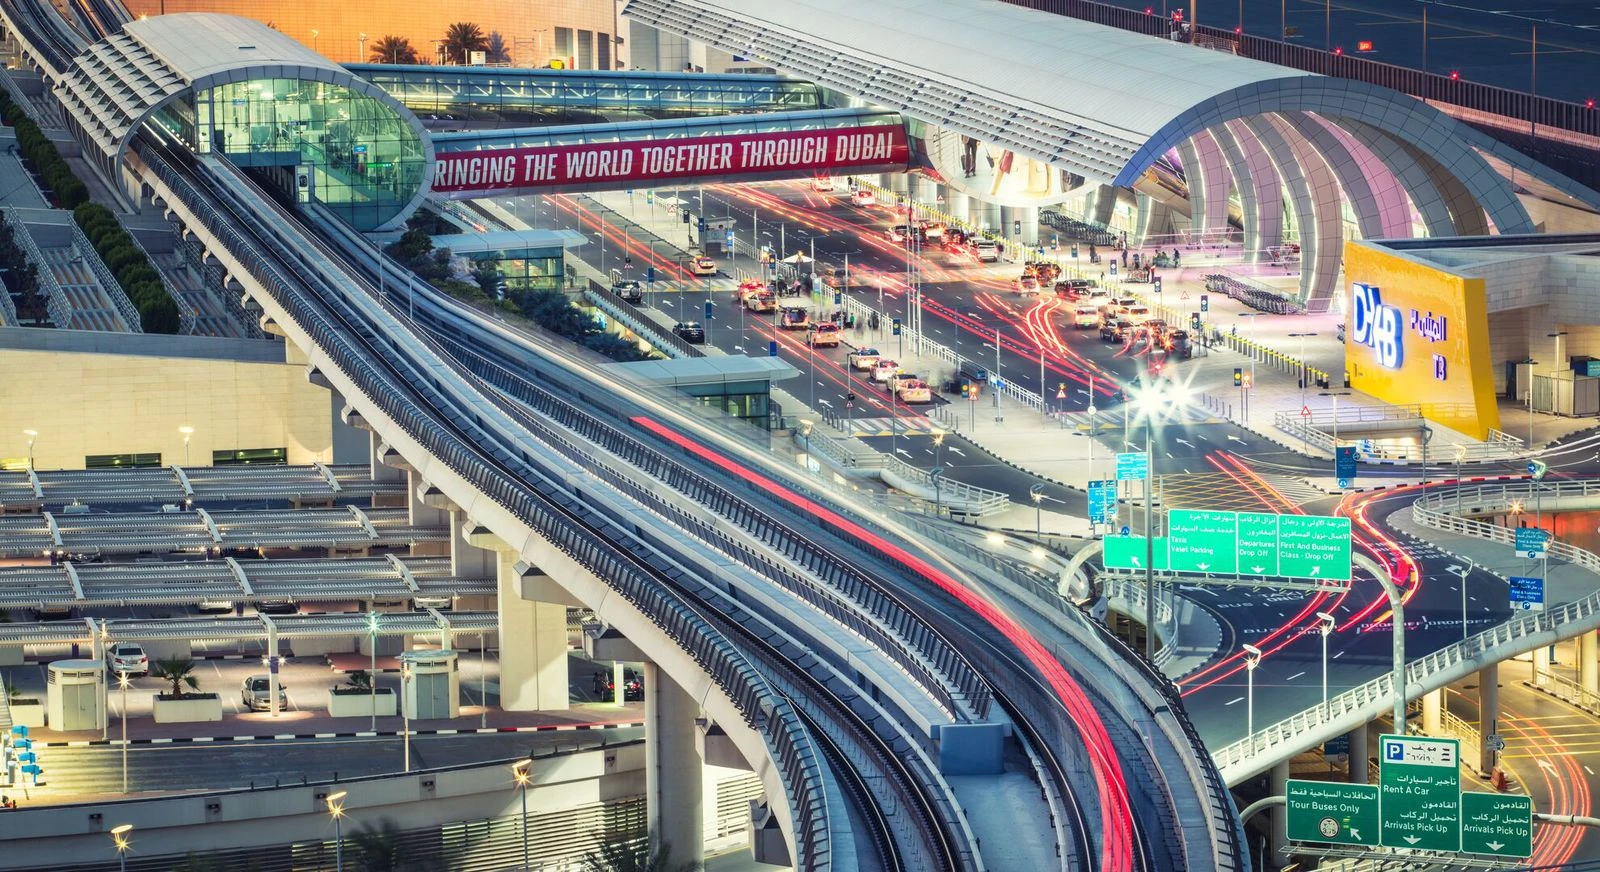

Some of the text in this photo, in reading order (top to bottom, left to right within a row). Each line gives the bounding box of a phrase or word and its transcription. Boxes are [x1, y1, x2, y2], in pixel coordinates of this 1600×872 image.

[524, 153, 559, 182] THE
[565, 149, 633, 179] WORLD
[641, 142, 732, 178] TOGETHER
[740, 136, 828, 168] THROUGH
[835, 132, 893, 163] DUBAI
[1432, 353, 1447, 381] T3
[1239, 539, 1276, 549] Departures
[1280, 541, 1341, 552] First And Business
[1190, 546, 1214, 556] Parking
[1239, 549, 1269, 558] Drop Off
[1280, 551, 1300, 559] Class
[1305, 552, 1321, 561] Drop
[1322, 553, 1335, 561] Off
[1389, 744, 1401, 759] P
[1397, 774, 1456, 786] تأجير السيارات
[1289, 787, 1376, 801] الحافلات السياحية فقط
[1383, 785, 1430, 796] Rent A Car
[1289, 800, 1360, 814] Tour Buses Only
[1421, 800, 1456, 809] القادمون
[1493, 801, 1529, 810] القادمون
[1400, 811, 1456, 822] تحميل الركاب
[1471, 813, 1529, 824] تحميل الركاب
[1383, 820, 1448, 834] Arrivals Pick Up
[1463, 823, 1528, 837] Arrivals Pick Up
